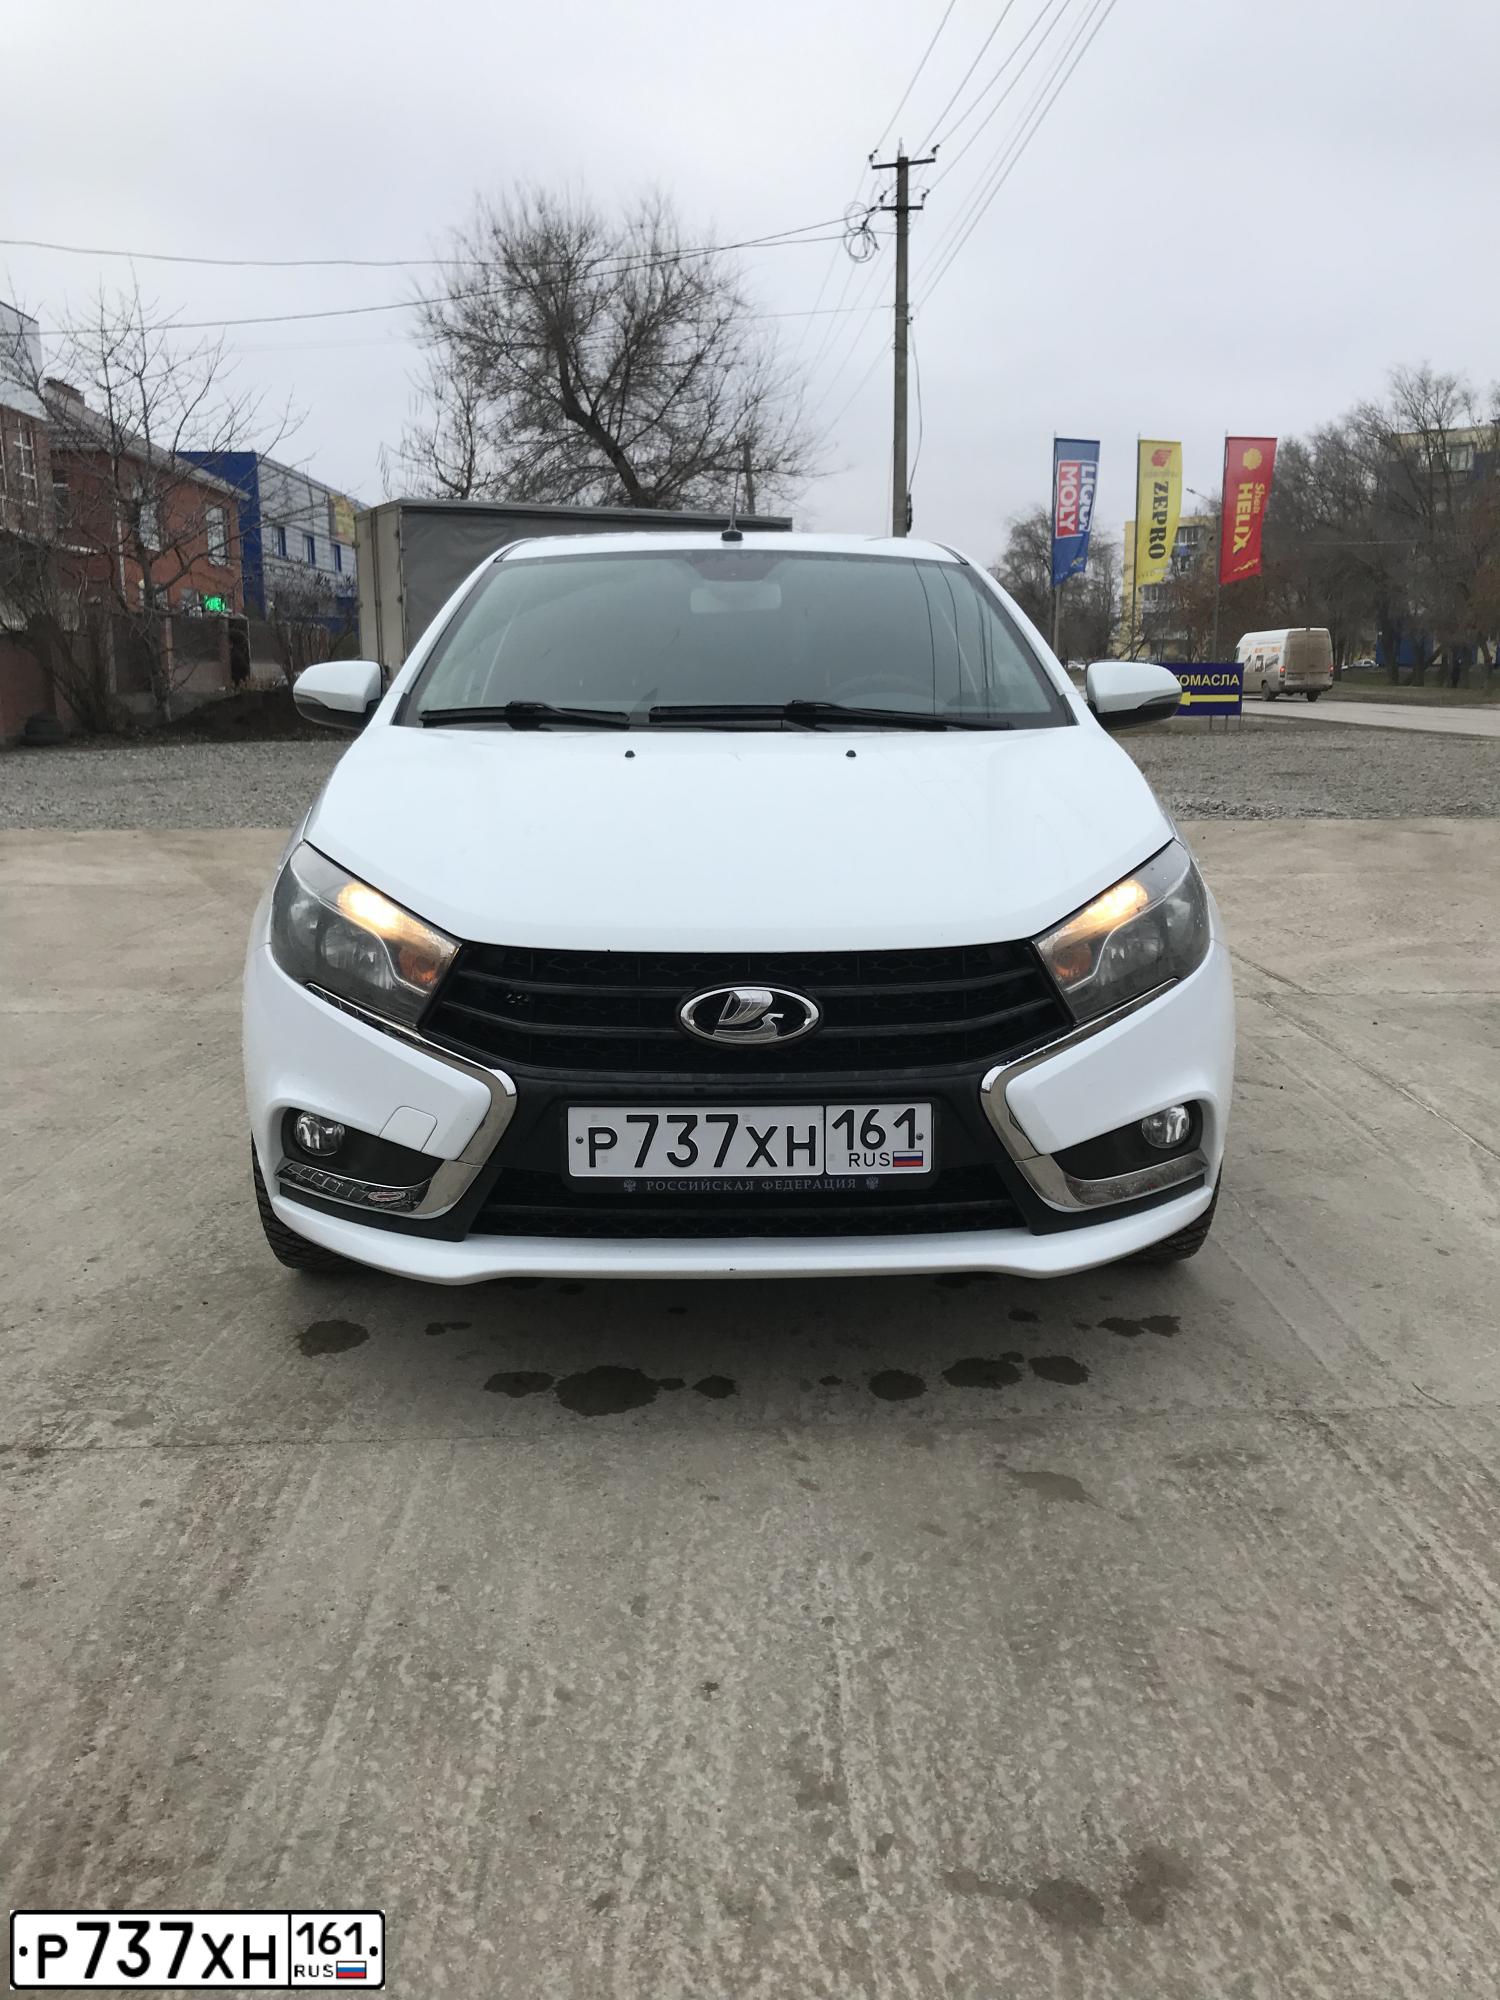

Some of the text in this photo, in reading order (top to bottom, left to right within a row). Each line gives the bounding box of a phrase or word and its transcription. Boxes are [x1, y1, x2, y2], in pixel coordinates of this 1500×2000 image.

[1059, 465, 1078, 532] MOLY
[1148, 480, 1169, 560] ZEPRO
[1232, 482, 1254, 554] HELIX
[831, 1108, 916, 1151] 161
[646, 1178, 857, 1192] РОССИЙСКАЯ ФЕДЕРАЦИЯ
[849, 1152, 891, 1168] RUS
